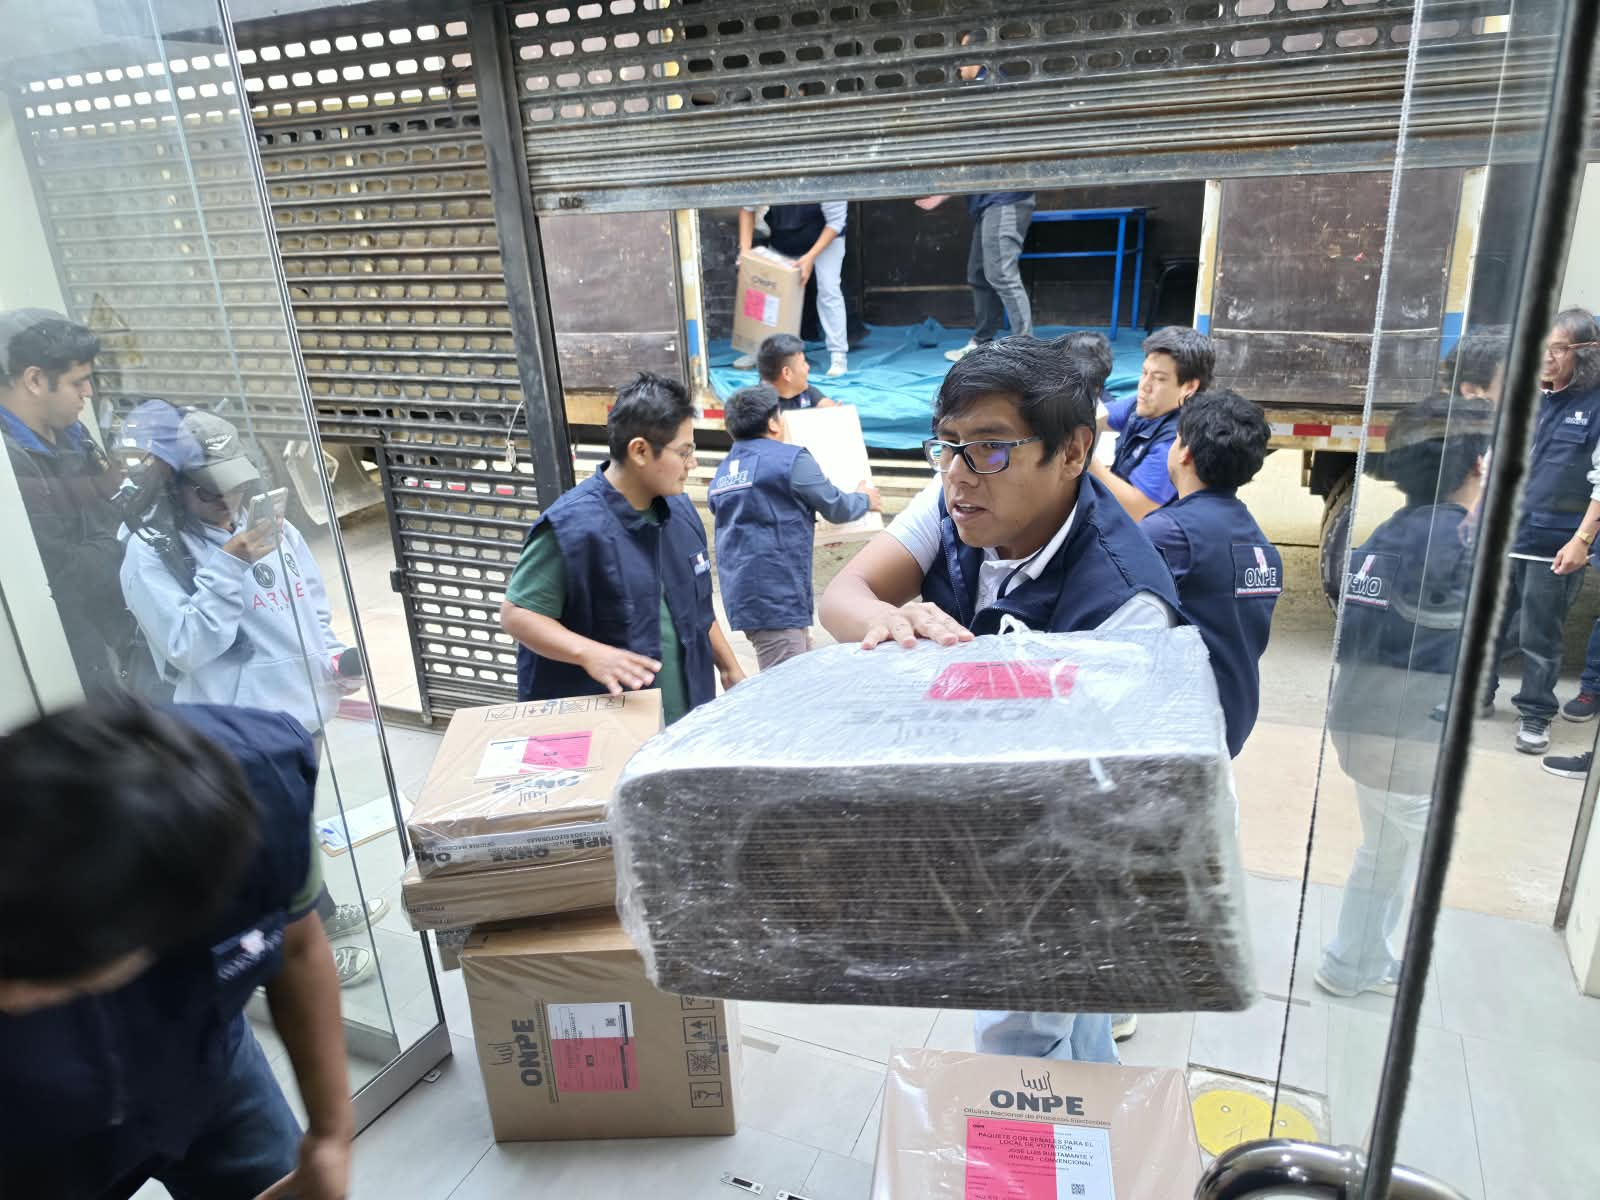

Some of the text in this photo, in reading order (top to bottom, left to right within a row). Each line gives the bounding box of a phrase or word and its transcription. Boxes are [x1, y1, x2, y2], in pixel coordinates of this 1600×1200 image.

[1245, 567, 1277, 587] ONPE
[511, 1019, 543, 1087] ONPE
[989, 1089, 1085, 1117] ONPE
[990, 1110, 1023, 1118] Nacional
[978, 1131, 1011, 1140] PAQUETE
[999, 1139, 1023, 1147] LOCAL
[1040, 1156, 1093, 1167] CONVENCIONAL
